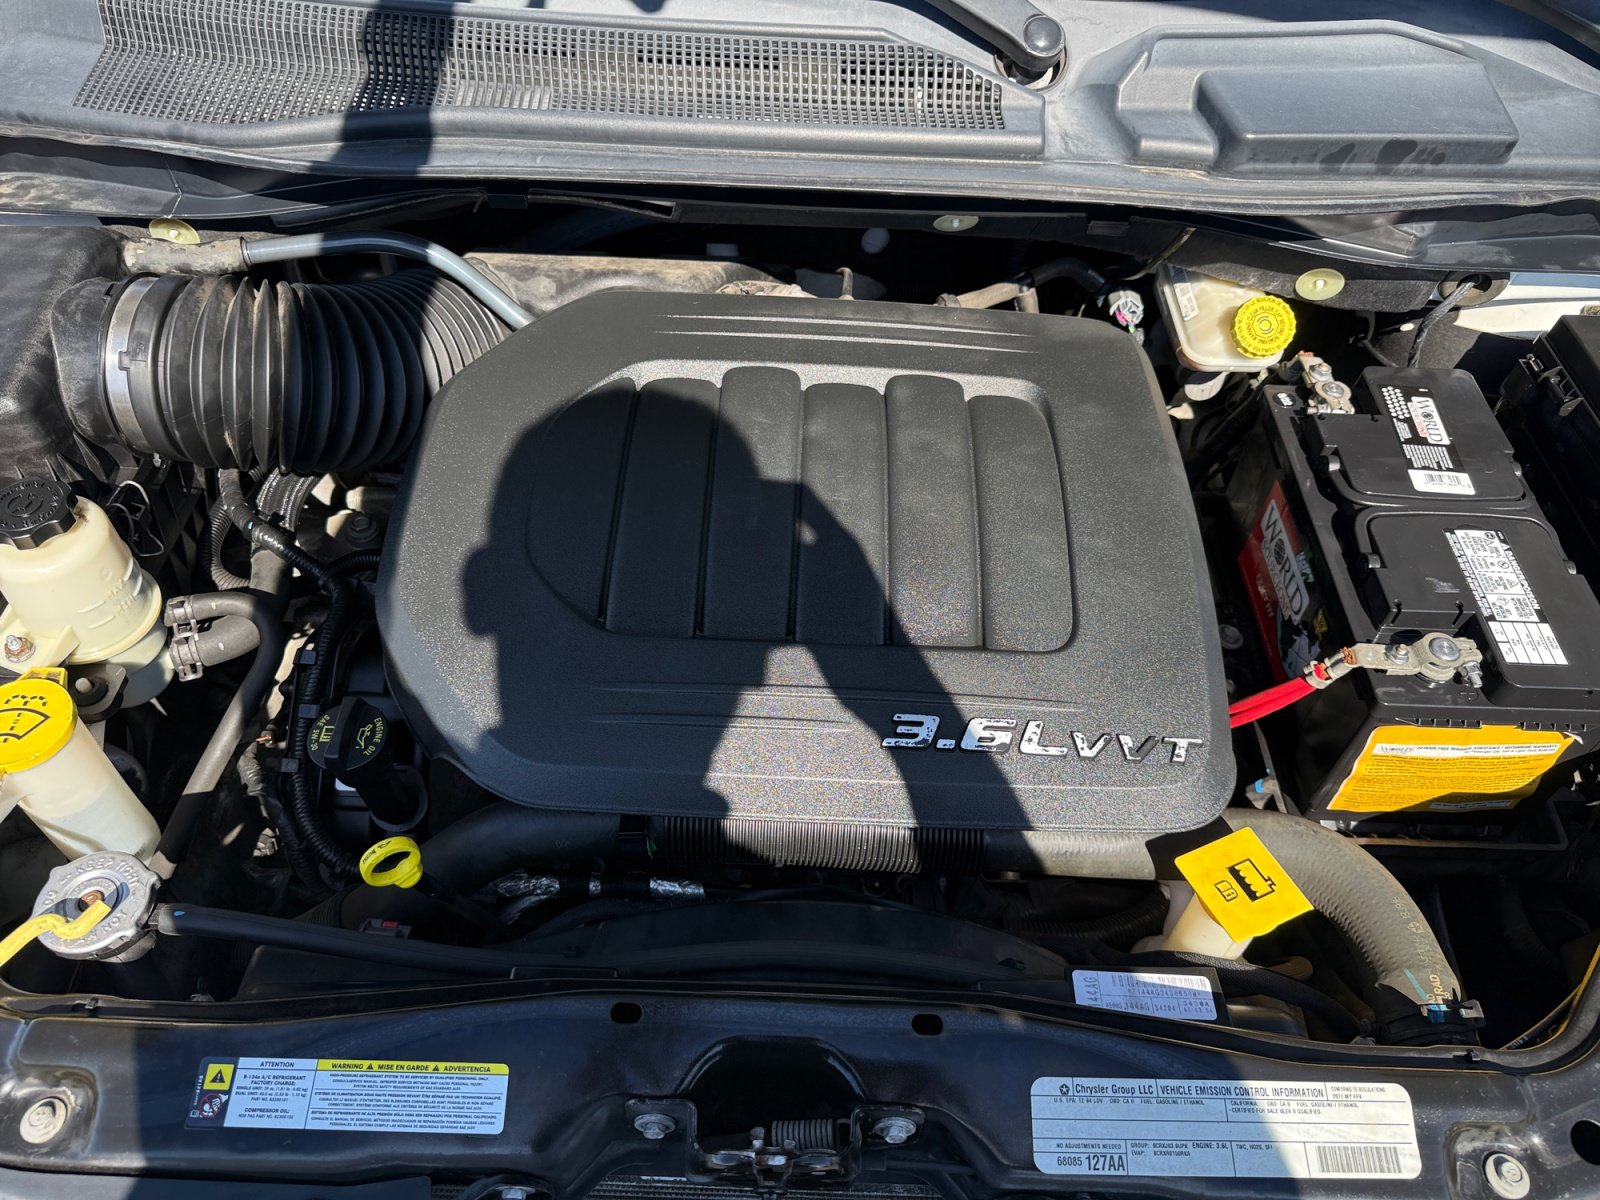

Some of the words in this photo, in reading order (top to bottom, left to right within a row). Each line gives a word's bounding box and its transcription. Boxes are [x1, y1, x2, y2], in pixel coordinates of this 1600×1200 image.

[1264, 507, 1304, 616] WORLD
[317, 714, 330, 727] SAE
[374, 717, 384, 743] ENGINE
[881, 713, 1068, 757] 3.6L
[1071, 731, 1202, 764] VVT
[363, 745, 376, 756] OIL
[1075, 1084, 1108, 1094] Chrysler
[1112, 1084, 1135, 1095] Group
[1138, 1085, 1153, 1094] LLC
[1160, 1086, 1192, 1095] VEHICLE
[1196, 1086, 1231, 1096] EMISSION
[1234, 1087, 1270, 1097] CONTROL
[1272, 1088, 1324, 1098] INFORMATION
[1057, 1156, 1082, 1166] 68085
[1085, 1155, 1125, 1171] 127AA
